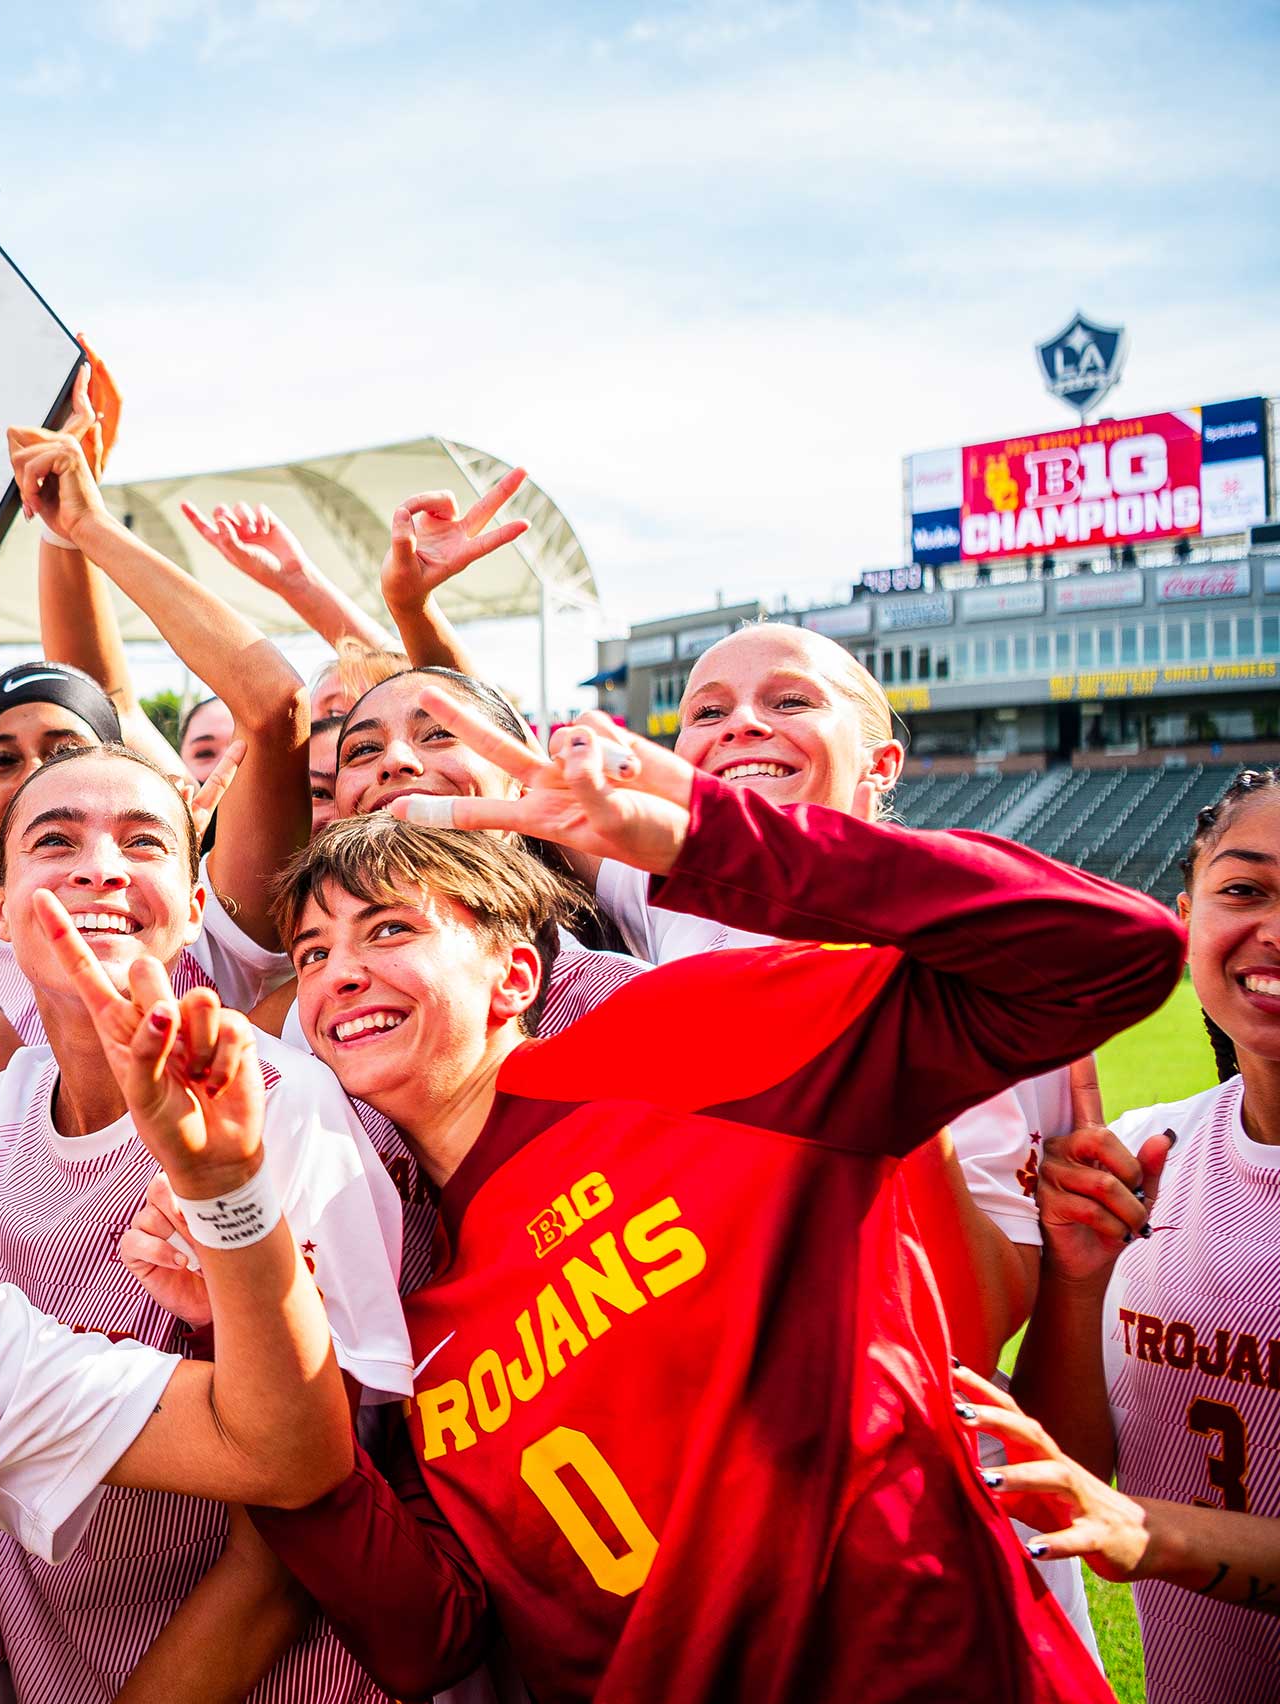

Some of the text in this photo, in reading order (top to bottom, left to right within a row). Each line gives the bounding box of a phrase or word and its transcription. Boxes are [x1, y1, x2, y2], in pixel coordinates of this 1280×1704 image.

[1054, 341, 1106, 376] LA
[961, 485, 1201, 555] CHAMPIONS
[402, 1196, 707, 1462] ROJANS
[519, 1426, 660, 1597] 0
[1187, 1395, 1249, 1513] 3
